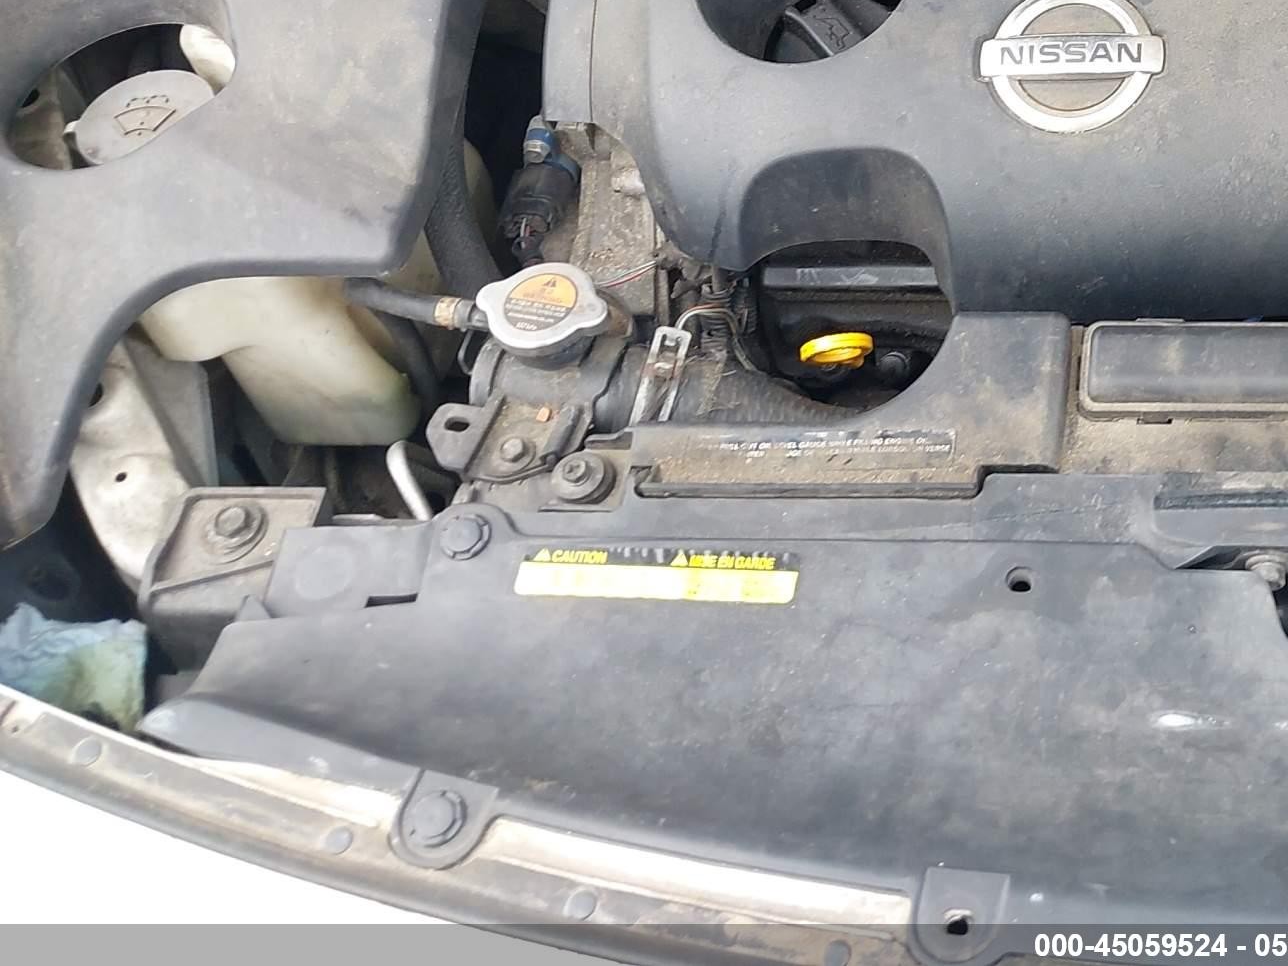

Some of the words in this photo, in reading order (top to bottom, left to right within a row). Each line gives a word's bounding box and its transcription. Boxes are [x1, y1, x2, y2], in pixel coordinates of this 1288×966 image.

[1000, 41, 1143, 65] NISSAN
[551, 549, 607, 564] CAUTION
[734, 556, 776, 570] GARDE
